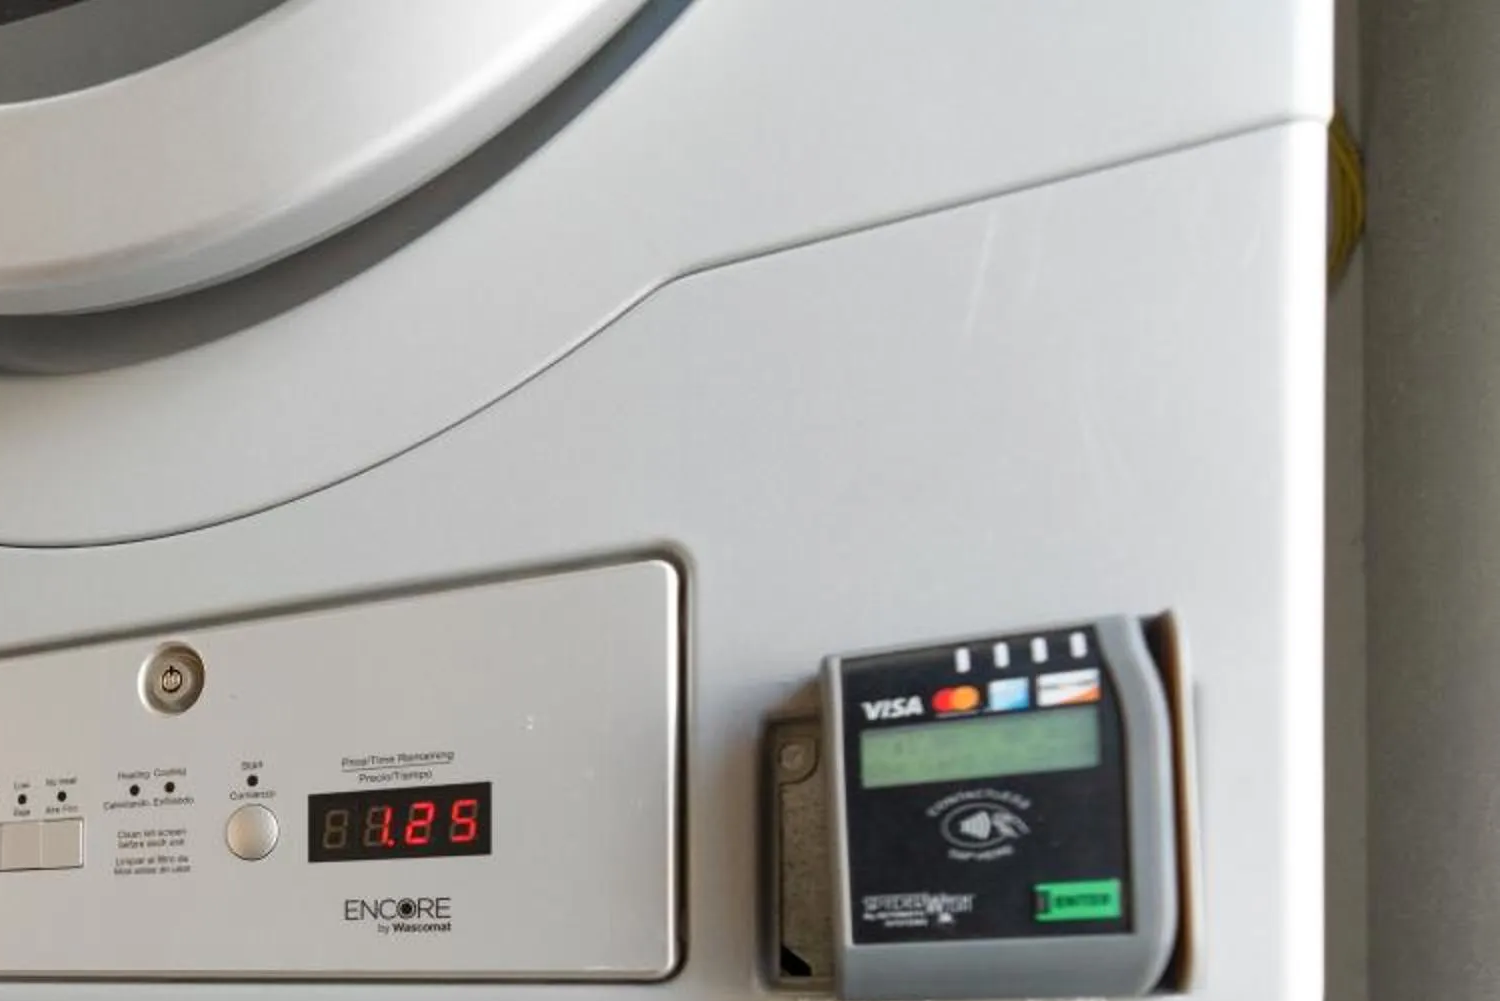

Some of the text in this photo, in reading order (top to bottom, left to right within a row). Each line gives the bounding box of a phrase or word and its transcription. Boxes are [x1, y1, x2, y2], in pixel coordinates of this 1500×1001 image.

[861, 695, 924, 720] VISA
[344, 897, 452, 921] ENCORE
[377, 922, 451, 934] by Wascomat
